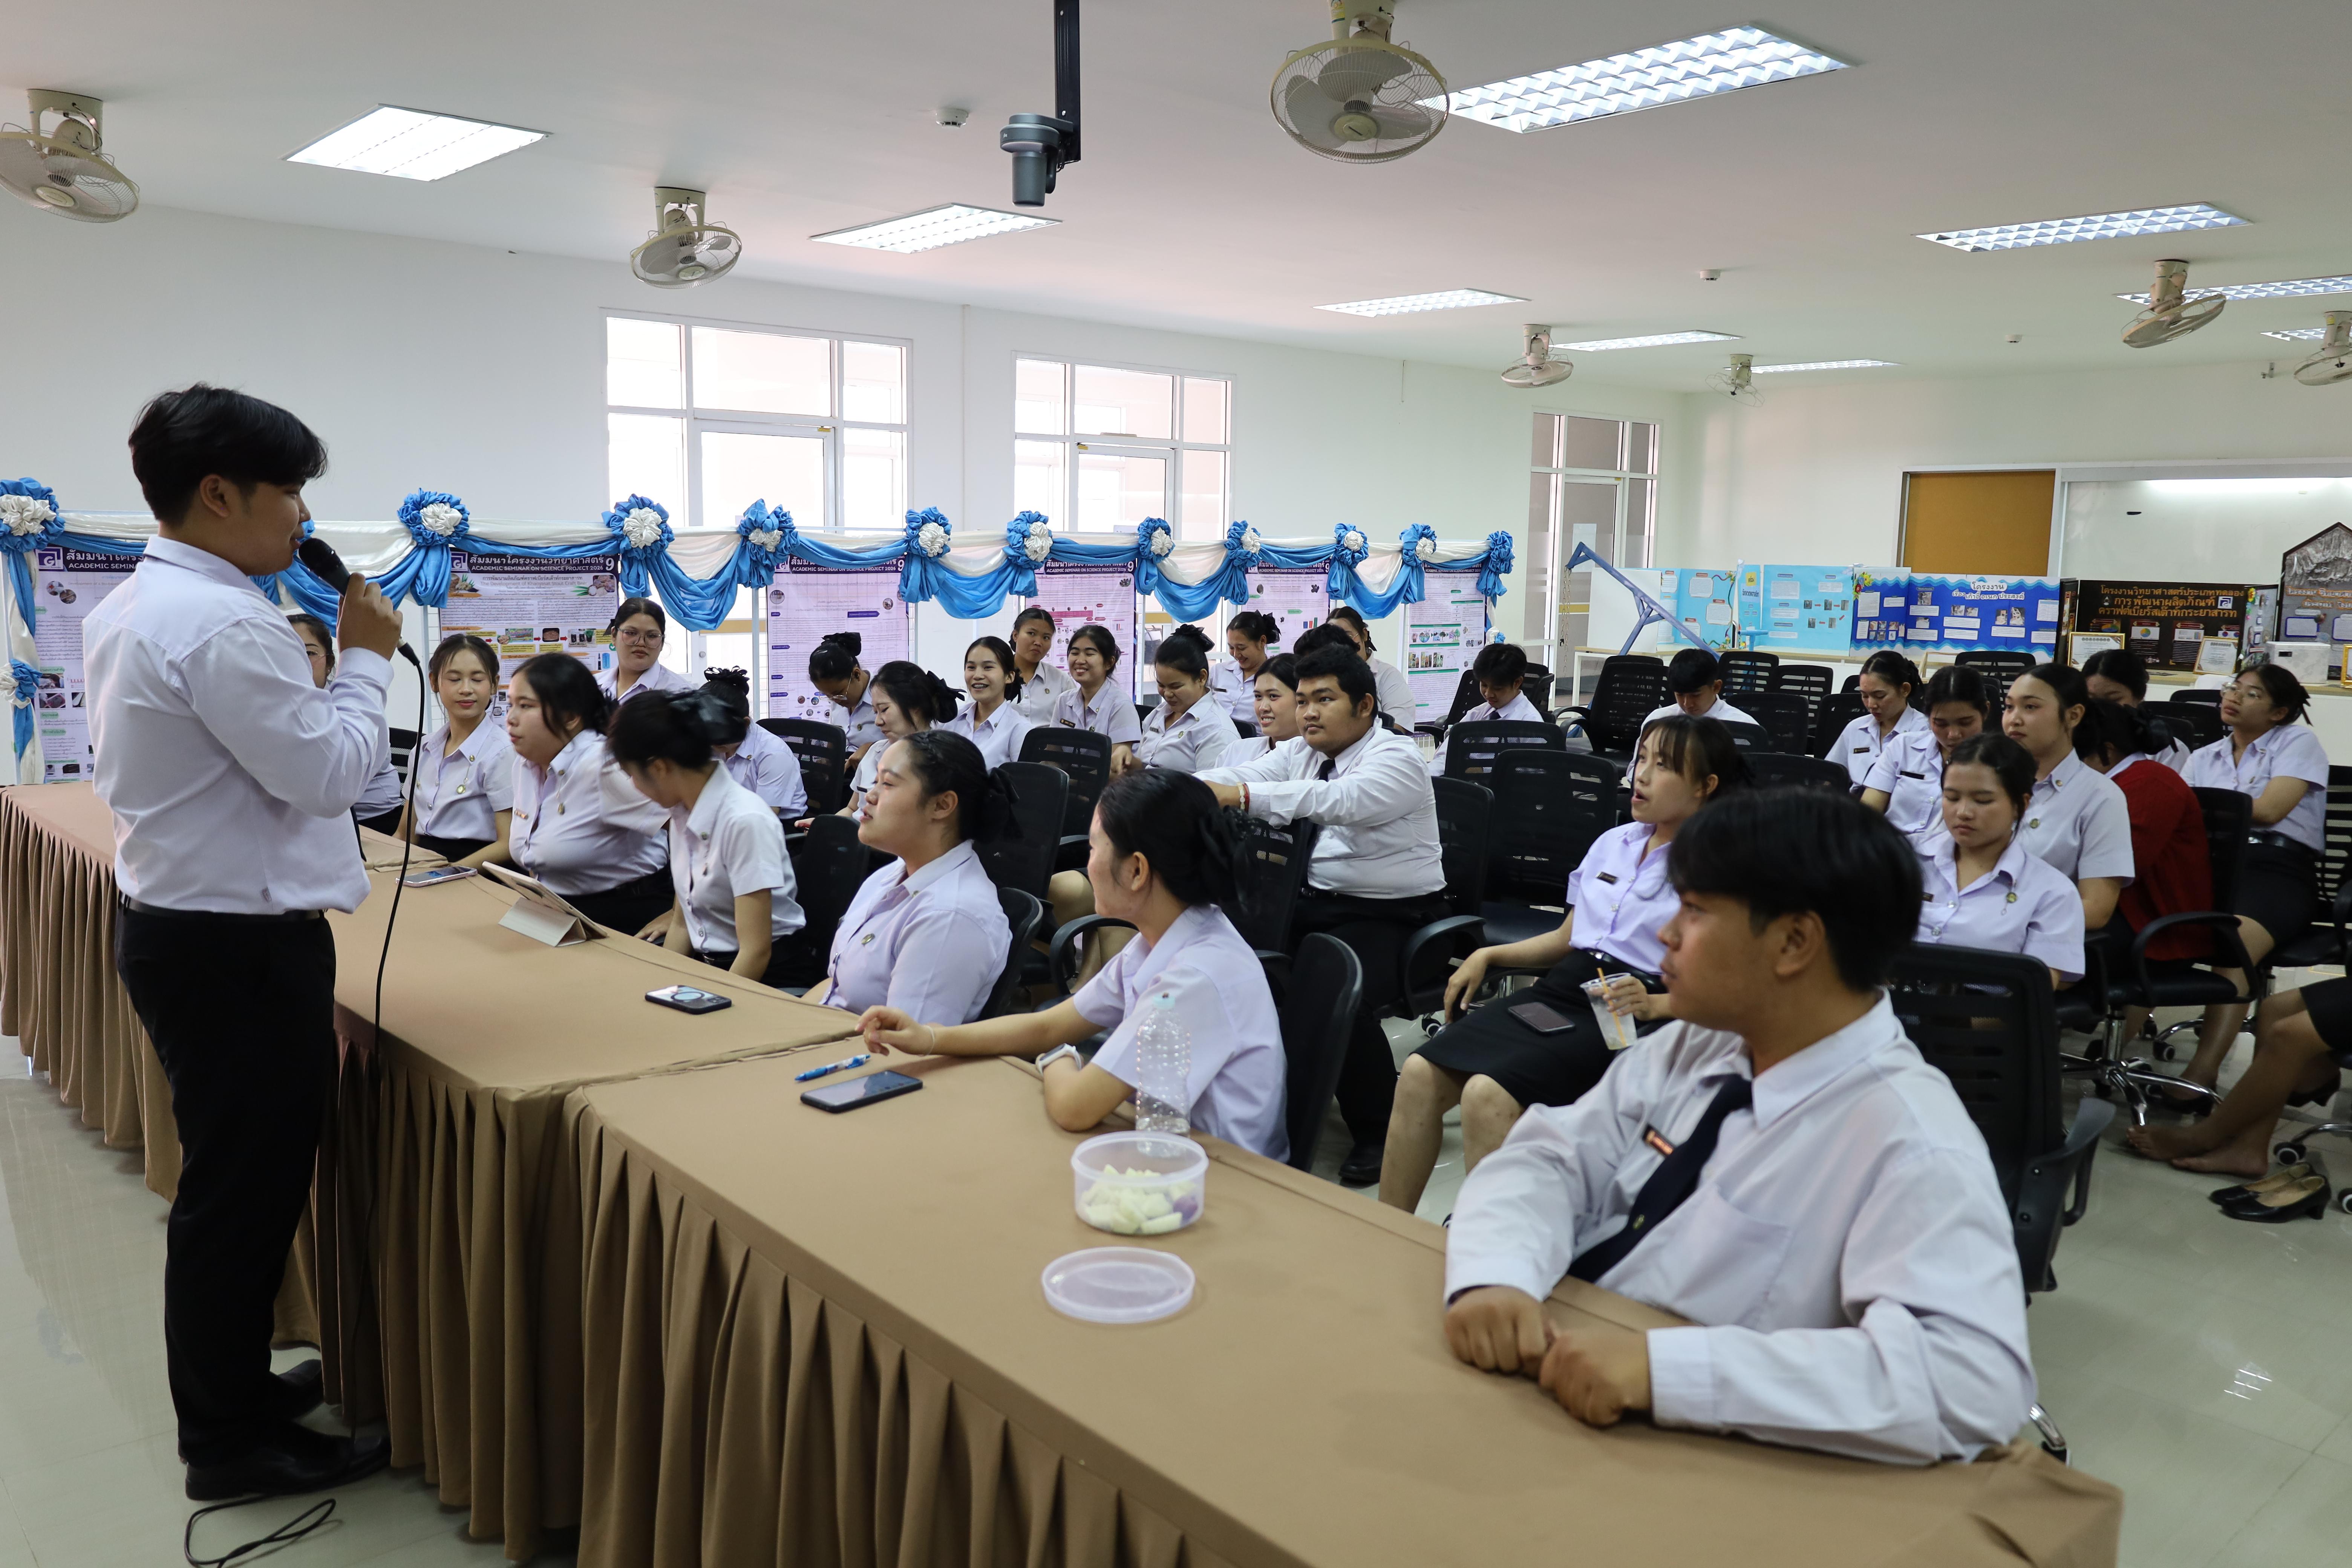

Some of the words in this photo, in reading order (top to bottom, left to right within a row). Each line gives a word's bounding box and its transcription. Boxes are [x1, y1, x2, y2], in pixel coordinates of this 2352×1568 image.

[470, 554, 604, 564] สัมมนาโครงงานวทยาศาสตร์
[605, 558, 614, 571] 9
[897, 559, 905, 571] 9
[1127, 561, 1134, 572] 9
[1325, 563, 1330, 573] 9
[1972, 581, 2004, 590] โครงงาน
